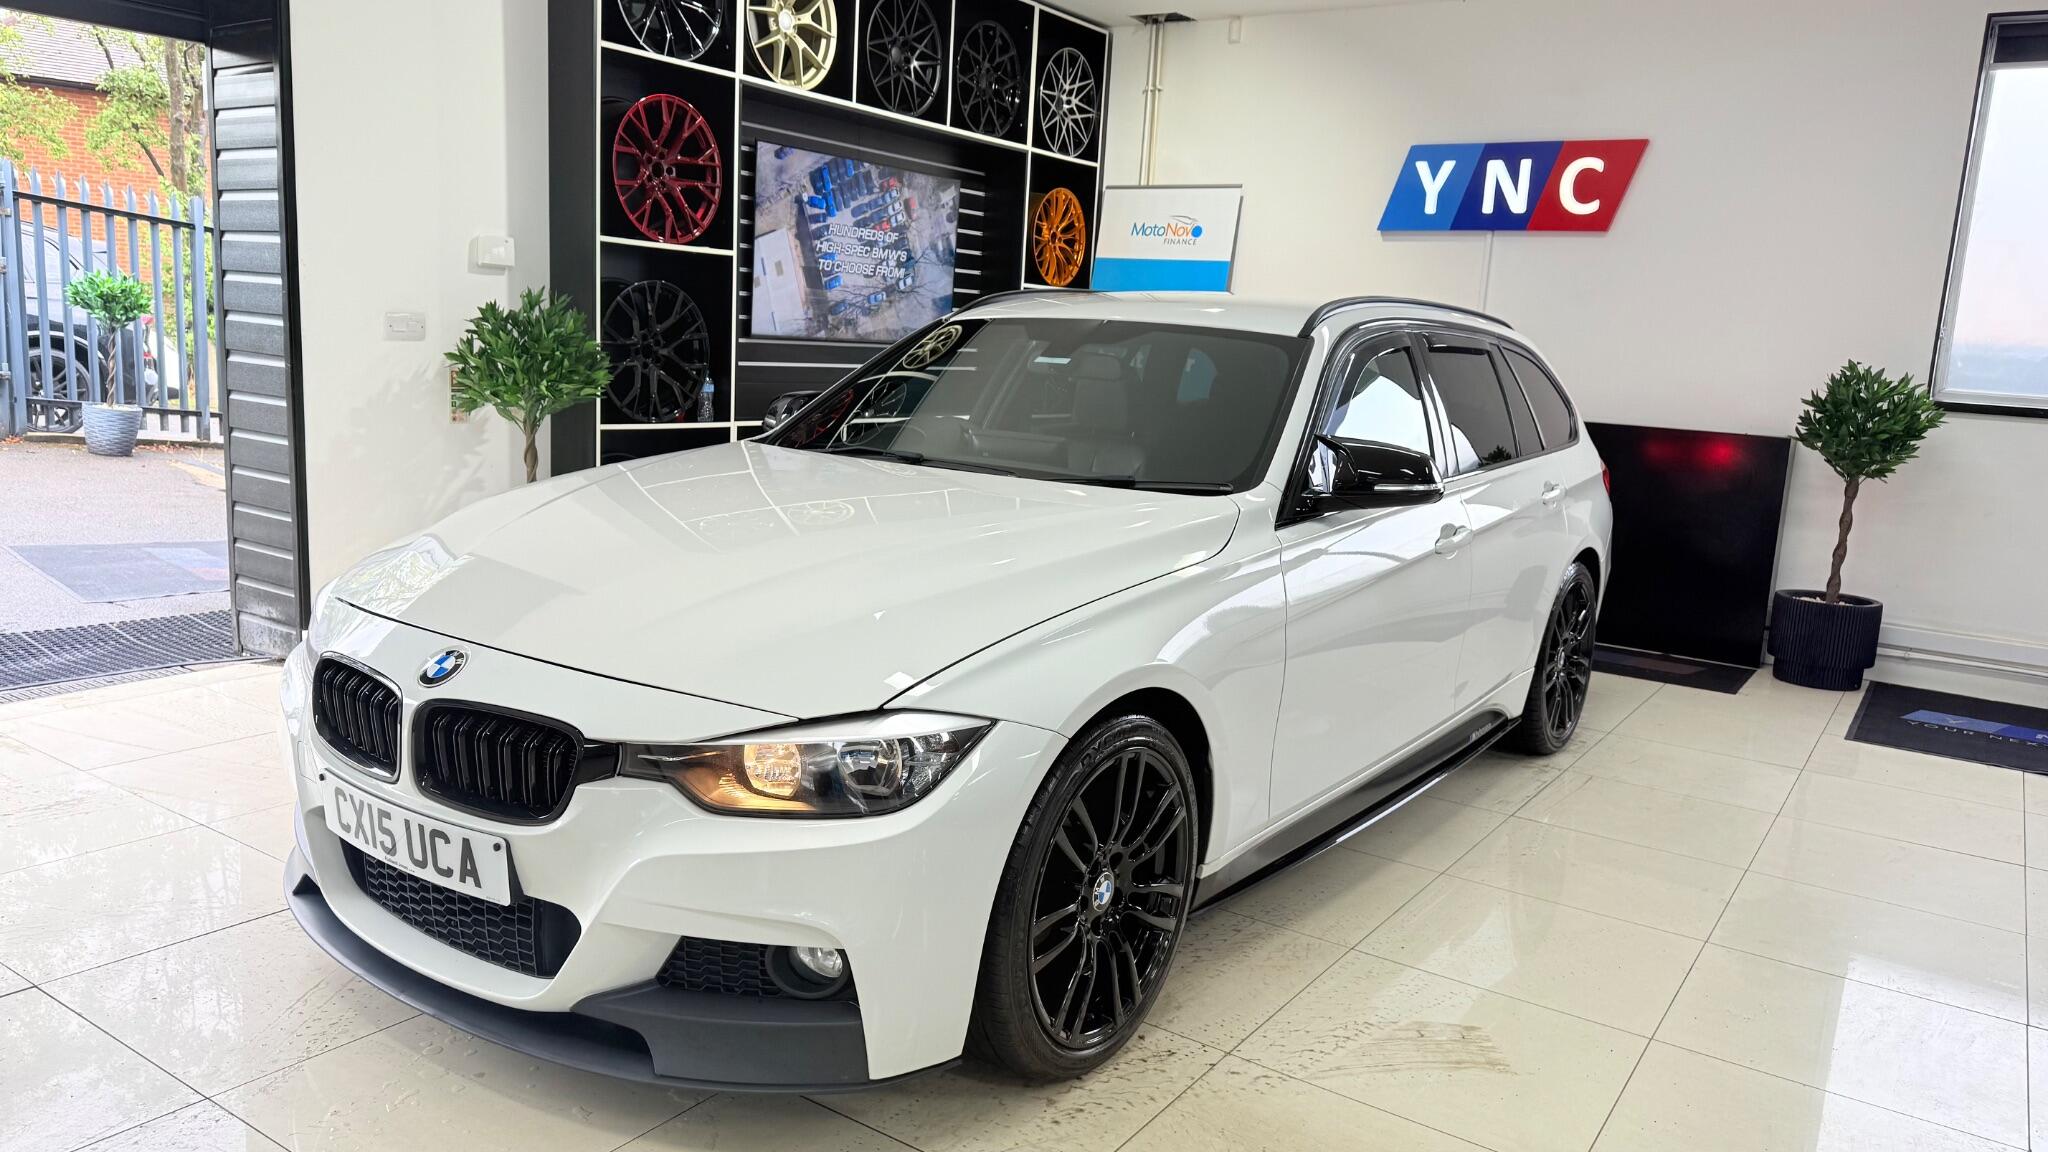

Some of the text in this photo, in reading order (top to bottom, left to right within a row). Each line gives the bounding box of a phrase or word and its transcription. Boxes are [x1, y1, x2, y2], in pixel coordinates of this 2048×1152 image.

[1415, 156, 1605, 215] YNC
[828, 223, 900, 243] HUNDREDS OF
[1131, 222, 1203, 238] MotoNovo
[1163, 238, 1198, 246] FINANCE
[816, 241, 908, 262] HIGH-SPEC BMW'S
[818, 259, 832, 270] TO
[834, 261, 876, 275] CHOOSE
[1989, 734, 2048, 748] NEX
[335, 786, 482, 888] CX15 UCA
